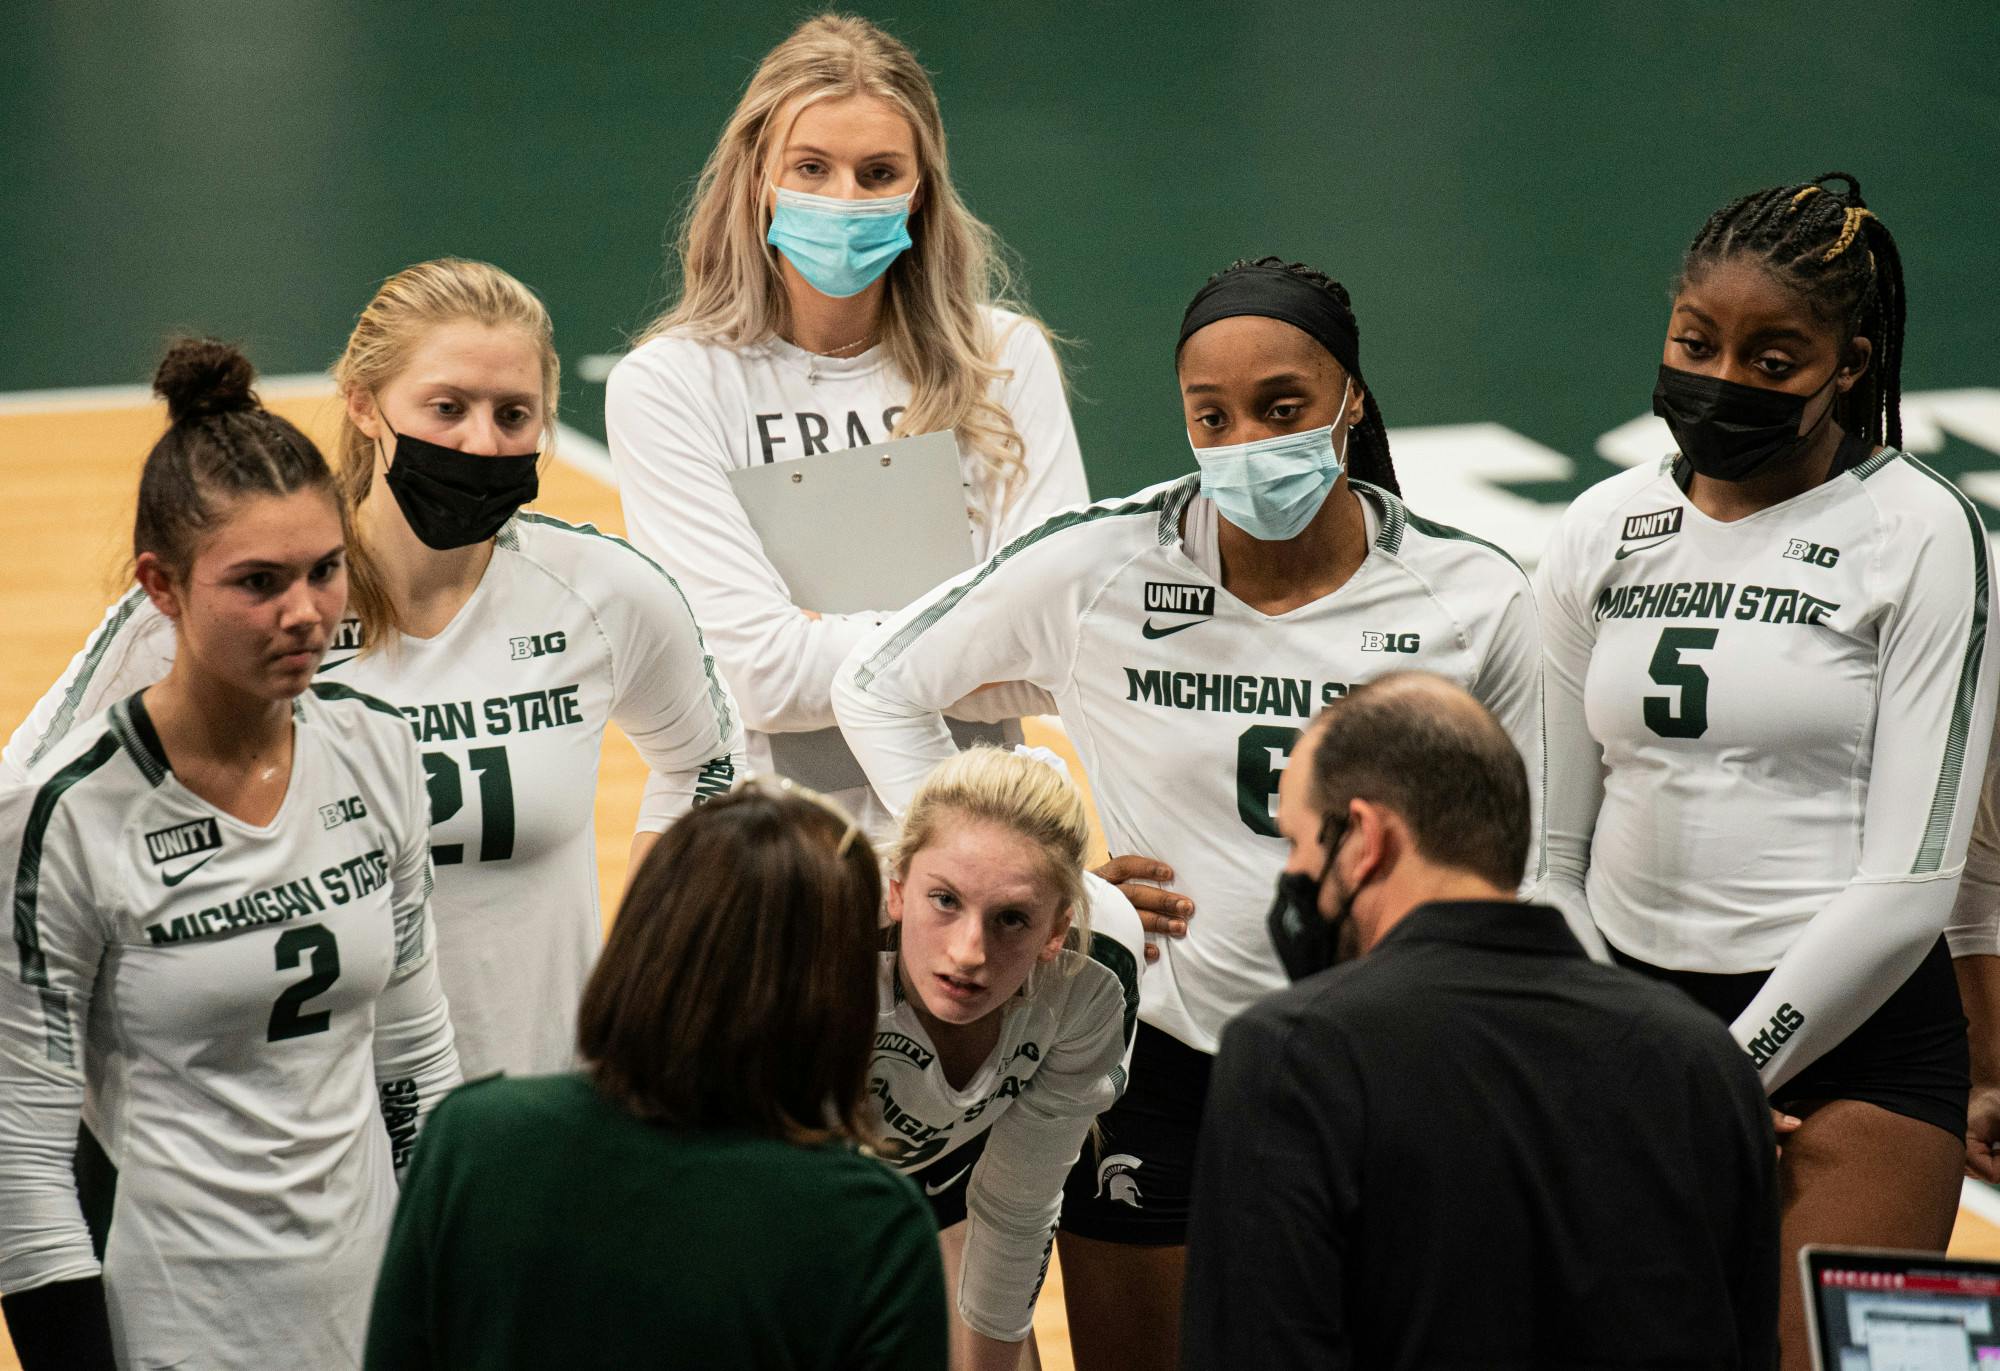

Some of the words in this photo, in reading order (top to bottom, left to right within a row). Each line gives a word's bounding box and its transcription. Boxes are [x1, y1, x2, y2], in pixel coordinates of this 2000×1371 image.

[1626, 508, 1678, 538] UNITY
[1147, 584, 1210, 612] UNITY
[1592, 582, 1736, 622] MICHIGAN
[1122, 667, 1311, 718] MICHIGAN
[1643, 627, 1720, 739] 5
[483, 684, 584, 736] STATE
[421, 745, 515, 866] 21
[1237, 724, 1304, 838] 6
[148, 819, 214, 862] UNITY
[146, 876, 326, 944] MICHIGAN
[267, 922, 341, 1043] 2
[876, 1033, 931, 1064] UNITY
